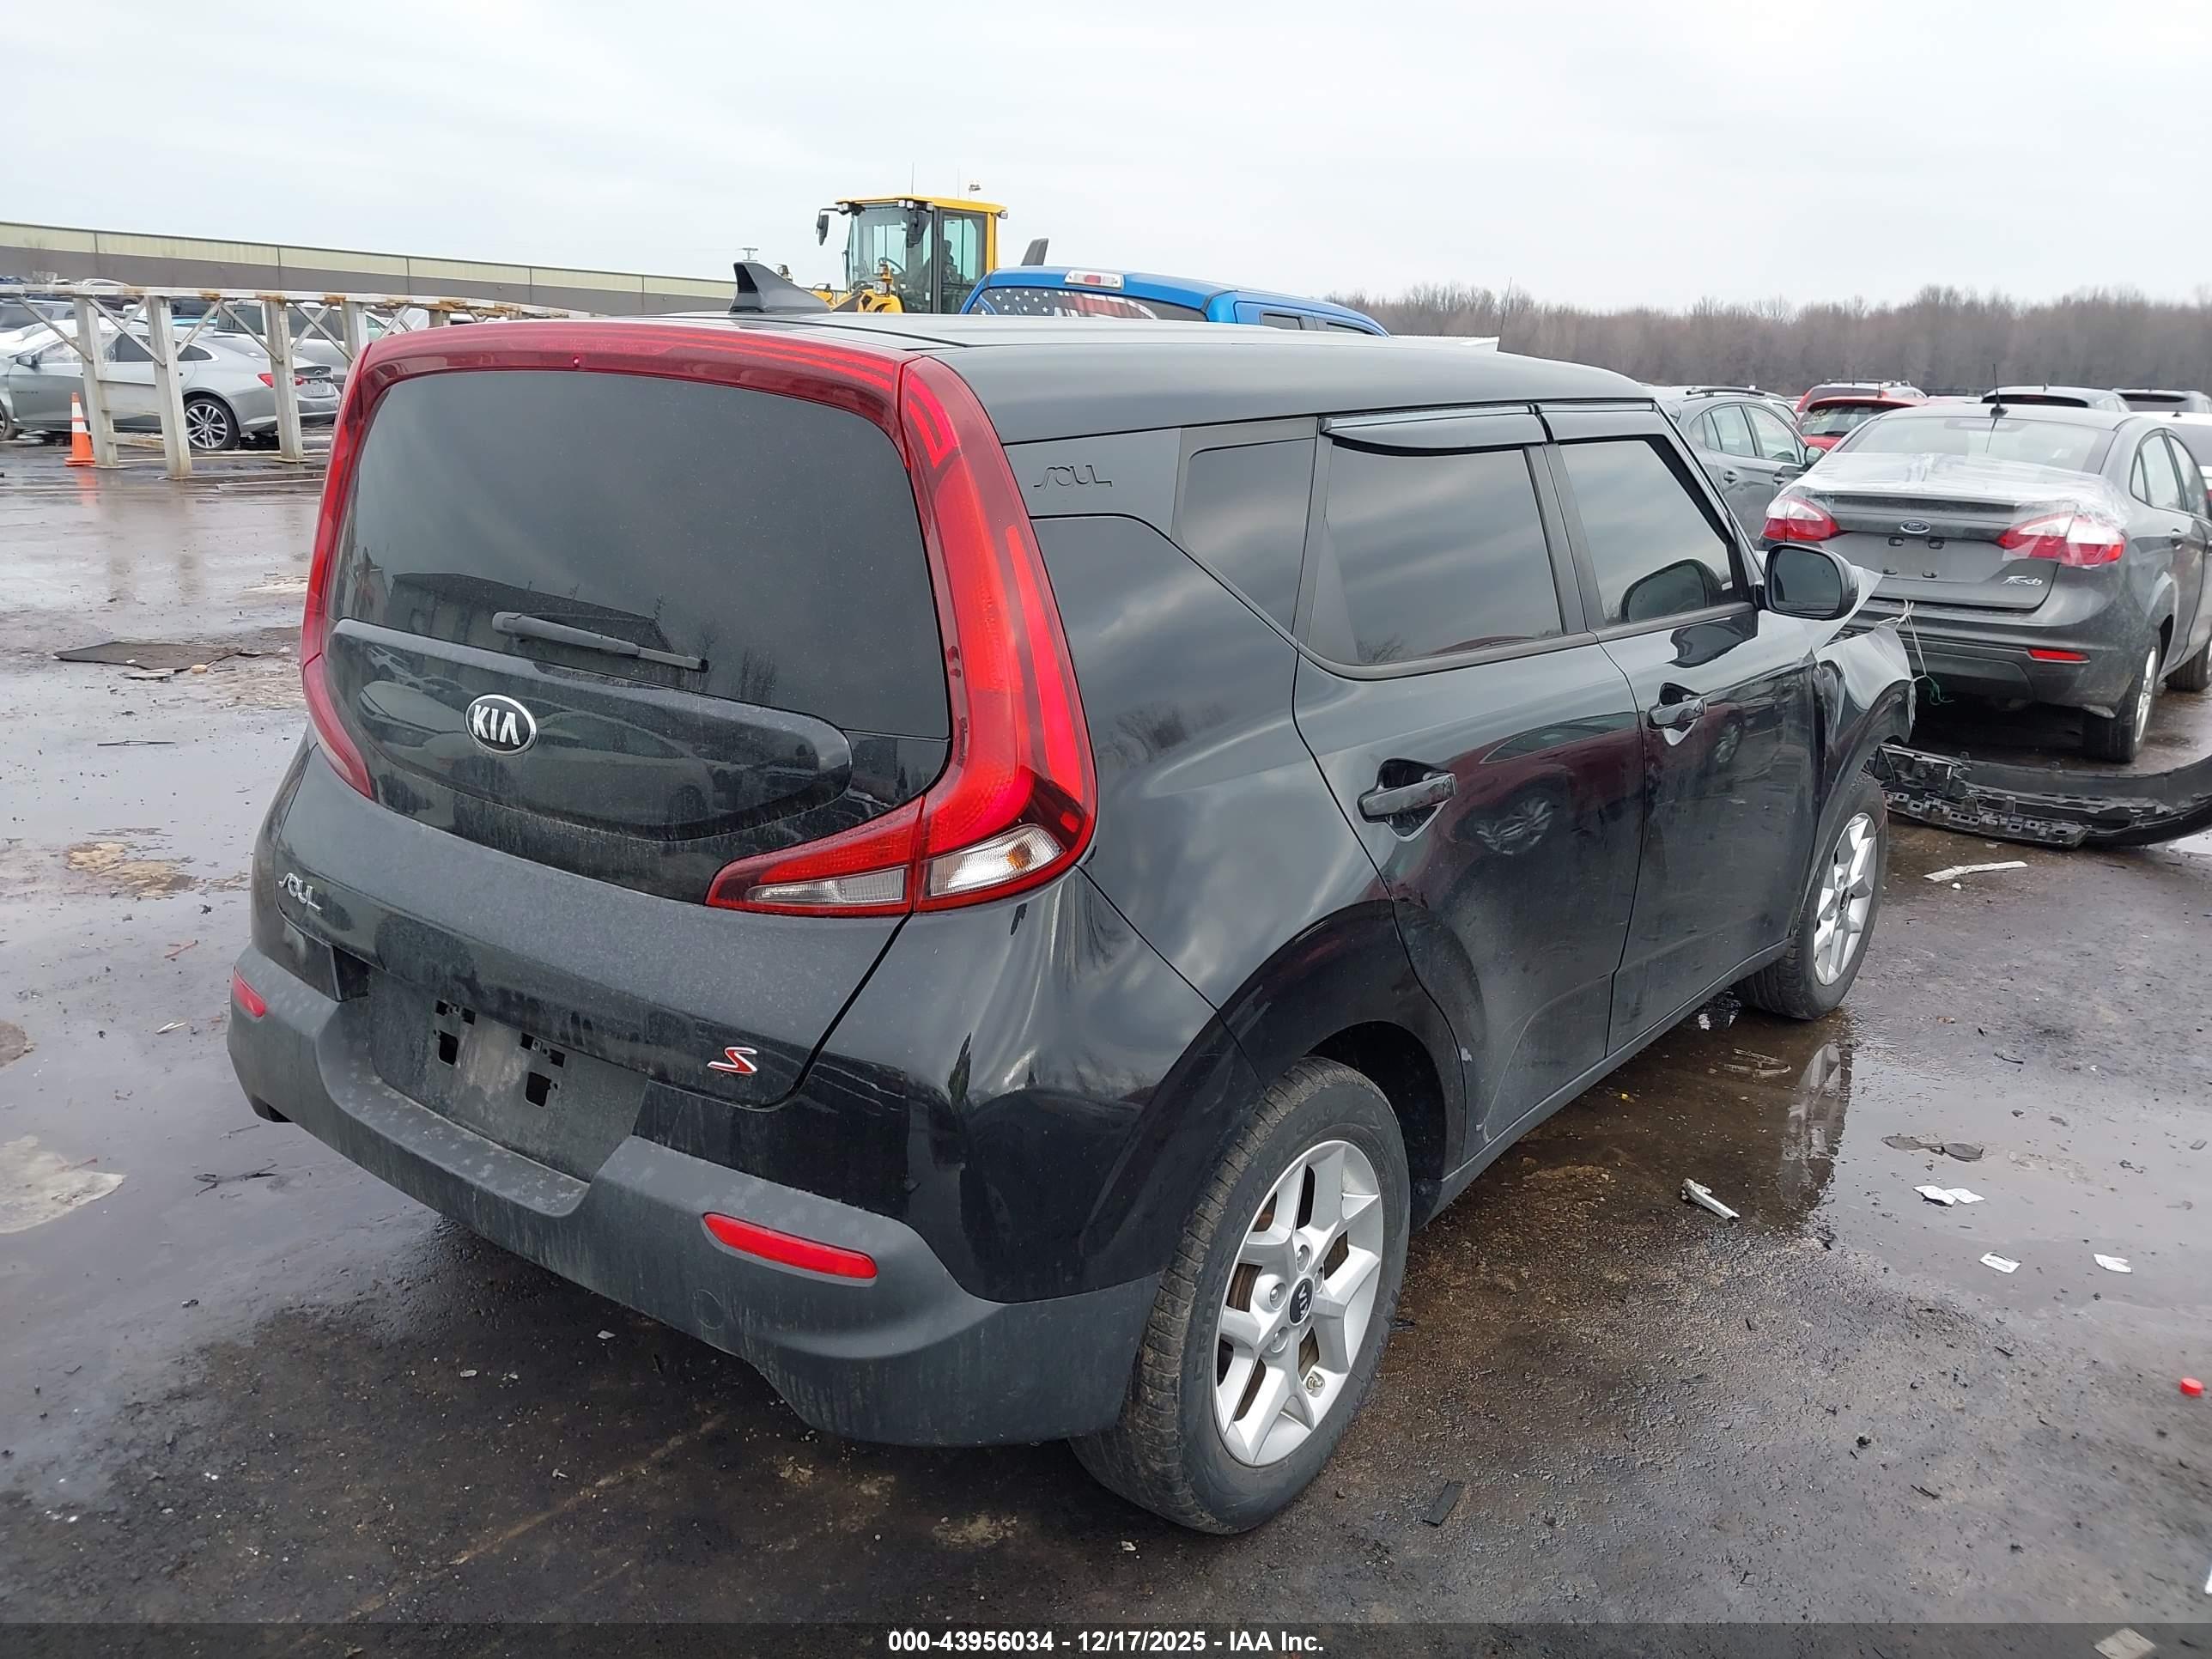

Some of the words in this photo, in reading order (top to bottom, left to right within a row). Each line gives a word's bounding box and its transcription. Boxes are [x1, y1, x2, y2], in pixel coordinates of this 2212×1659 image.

[1033, 465, 1113, 489] SOUL
[472, 704, 520, 745] KIA
[278, 872, 323, 916] SOUL
[707, 1046, 757, 1074] S
[1298, 1284, 1308, 1320] KIA
